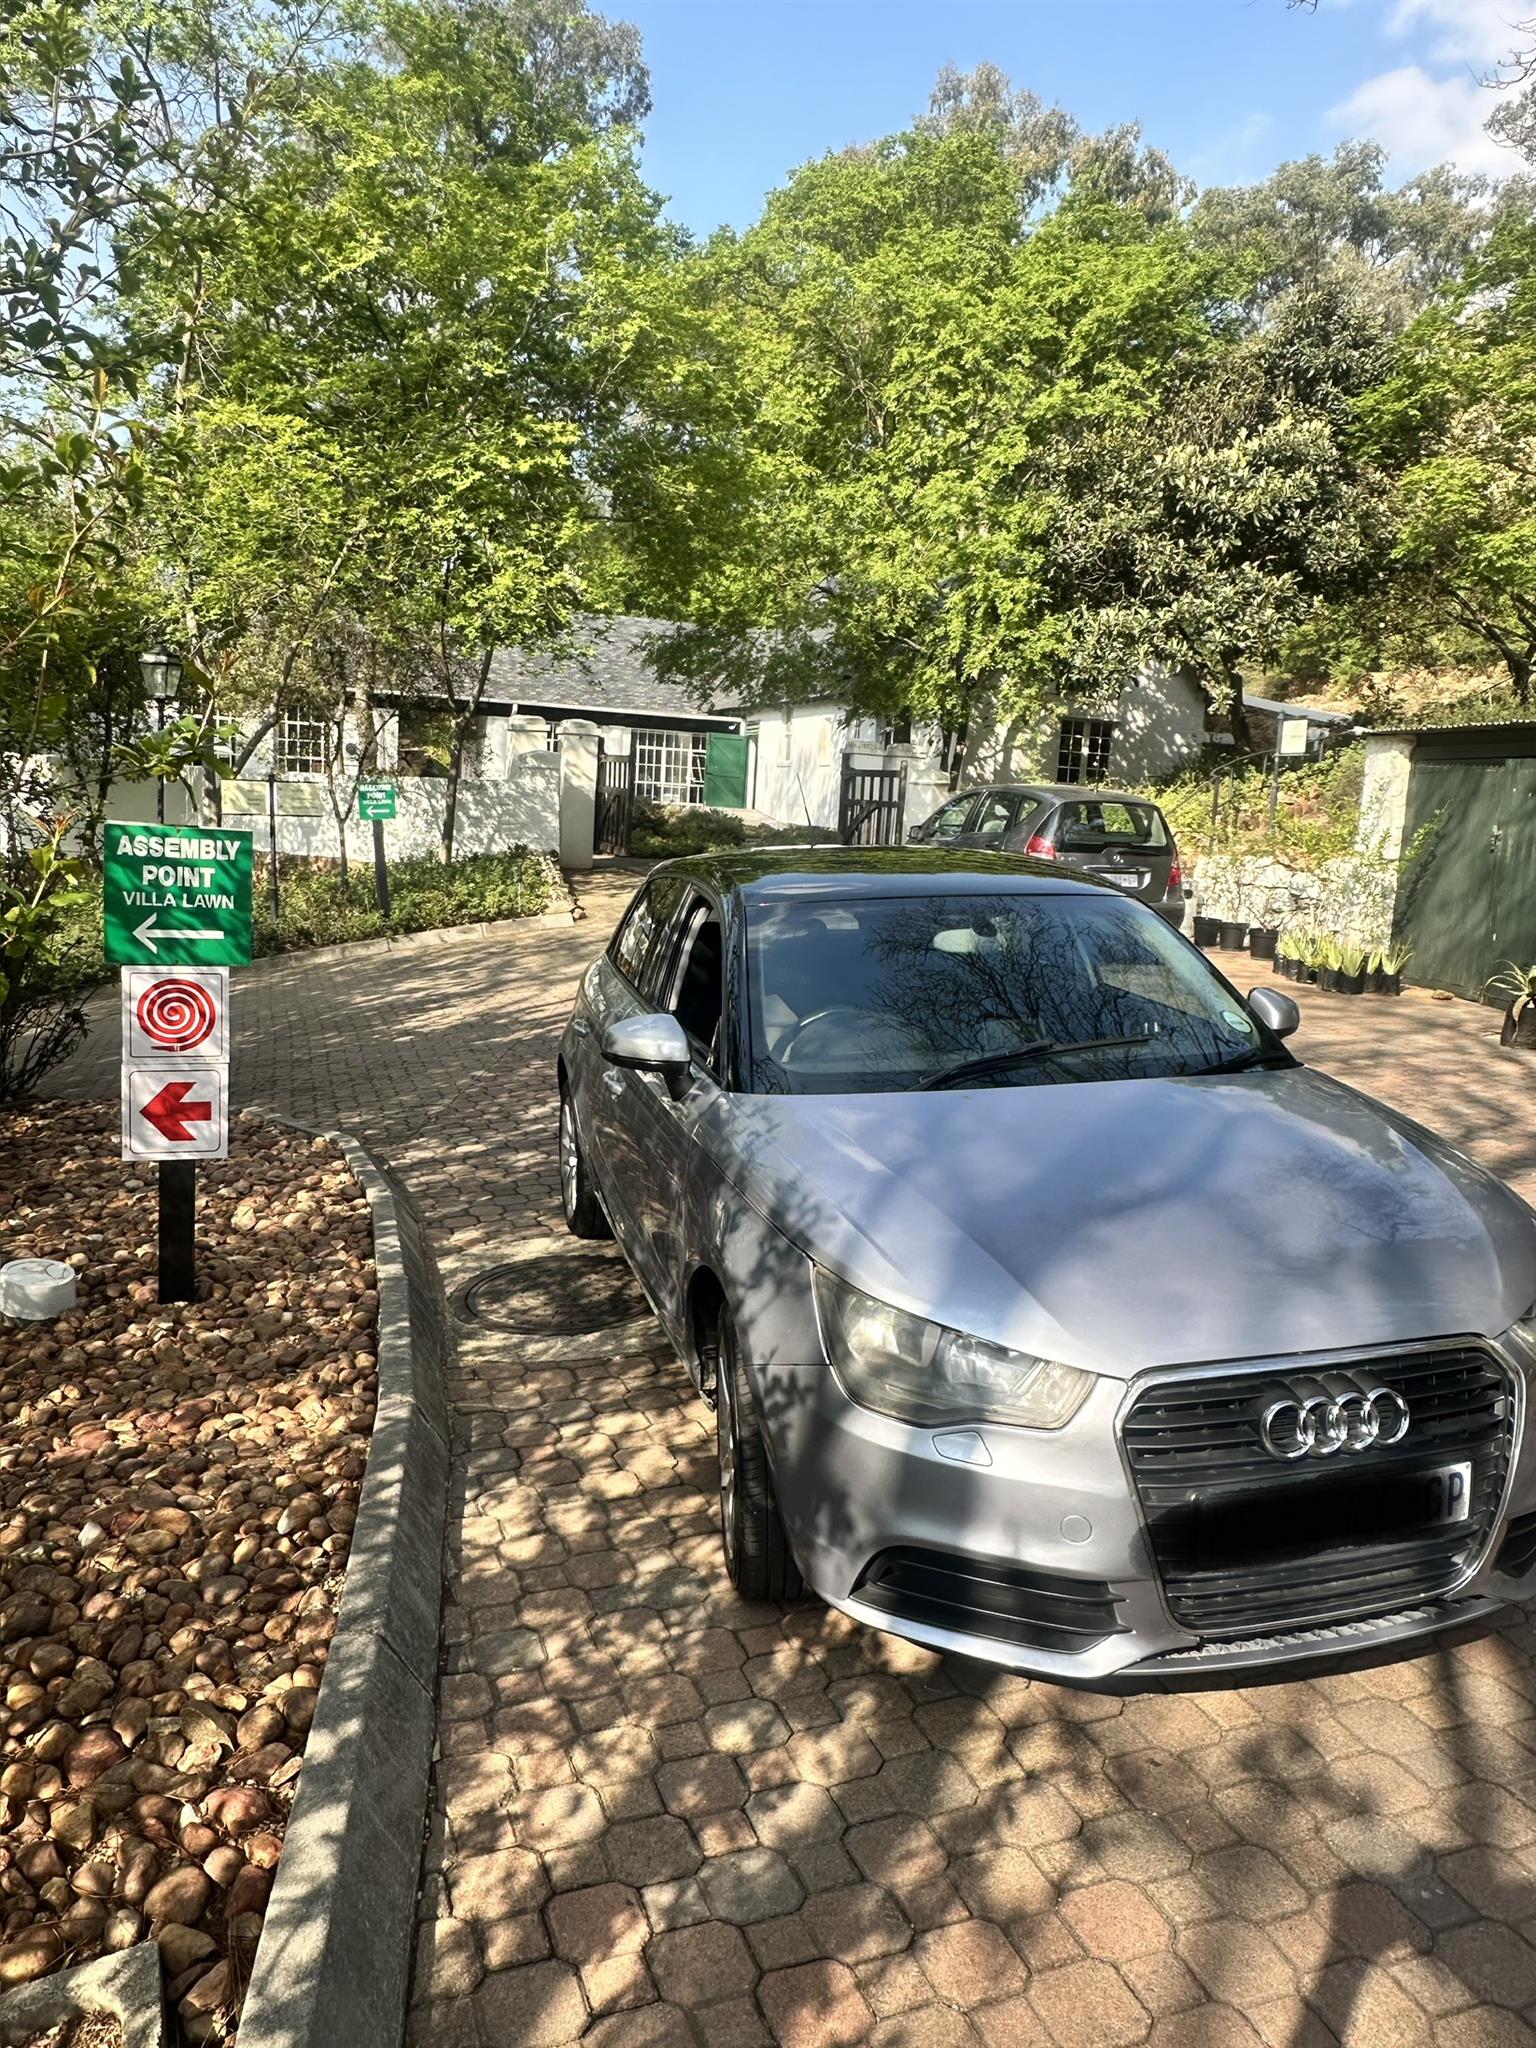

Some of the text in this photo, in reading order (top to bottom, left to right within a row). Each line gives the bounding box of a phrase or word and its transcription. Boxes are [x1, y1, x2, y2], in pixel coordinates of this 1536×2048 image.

[116, 835, 241, 861] ASSEMBLY
[142, 865, 216, 888] POINT
[122, 891, 235, 910] VILLA LAWN
